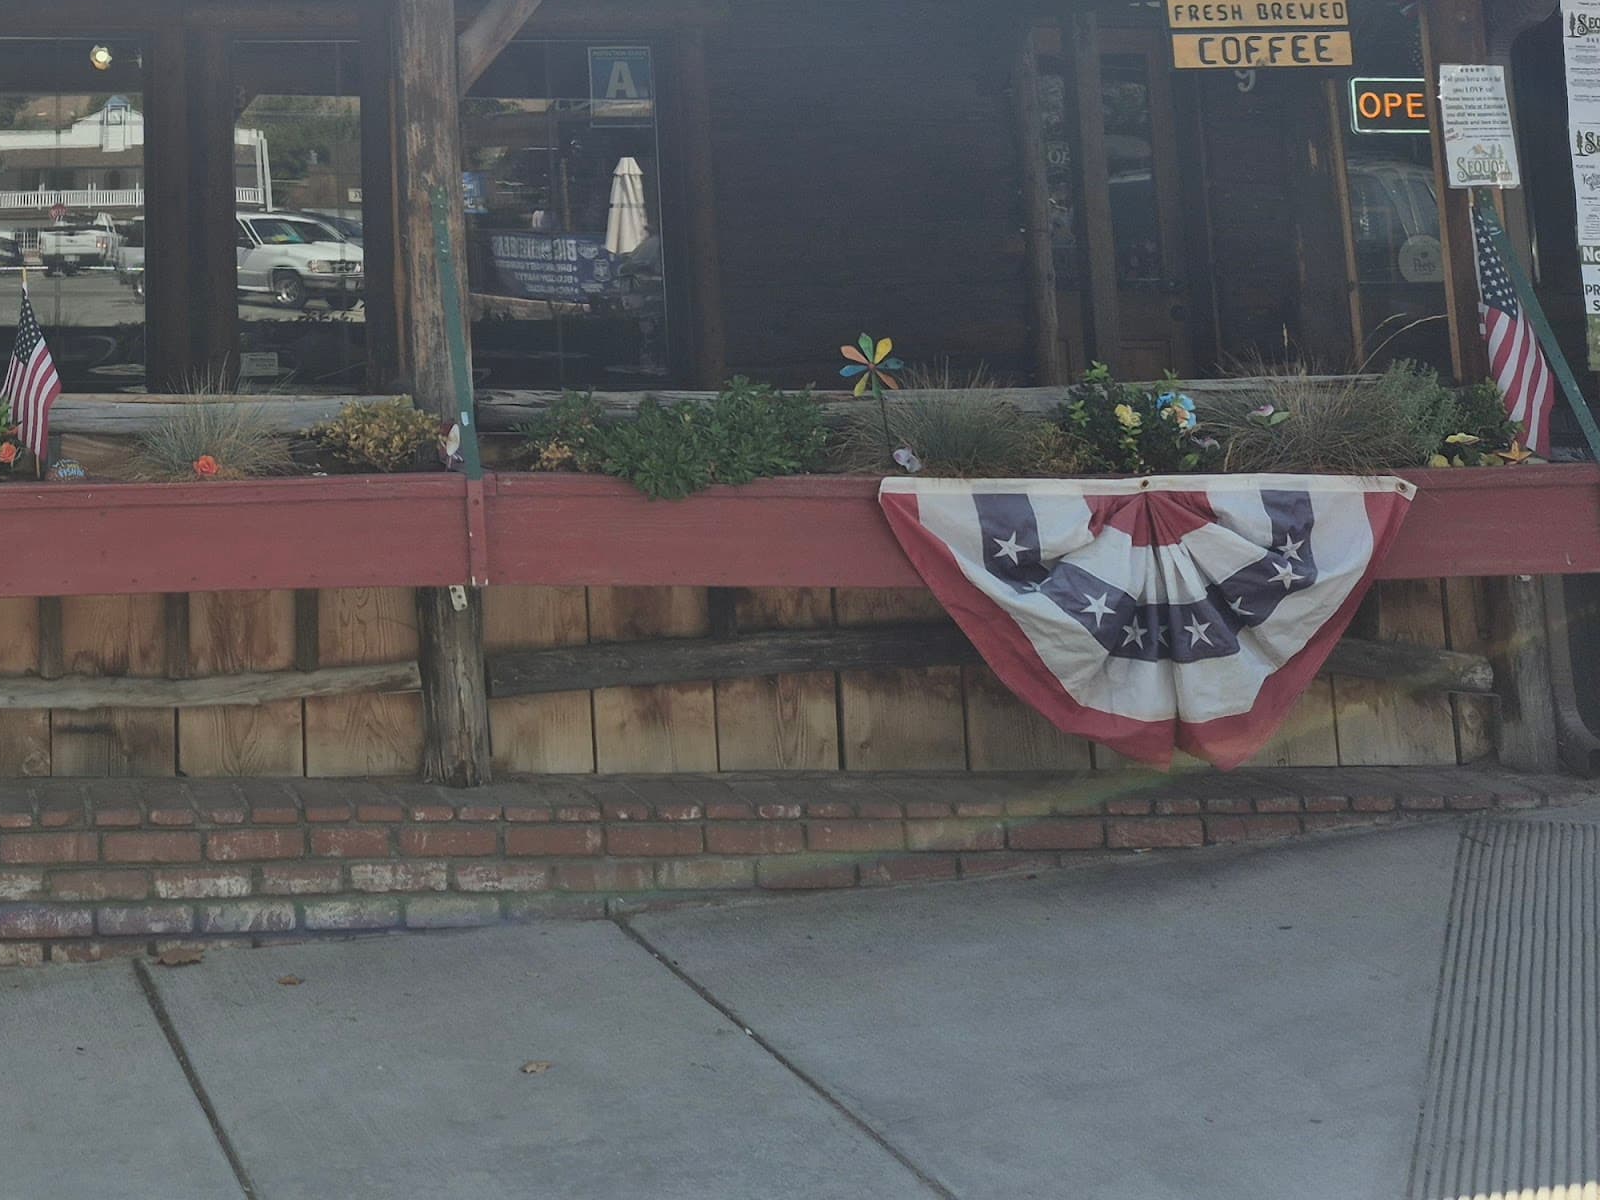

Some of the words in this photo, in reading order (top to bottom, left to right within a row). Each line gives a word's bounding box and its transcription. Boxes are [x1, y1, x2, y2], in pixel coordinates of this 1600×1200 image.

[1174, 4, 1243, 22] FRESH
[1257, 2, 1344, 21] BREWED
[1198, 34, 1334, 65] COFFEE
[605, 61, 638, 99] A
[1358, 91, 1426, 119] OPE
